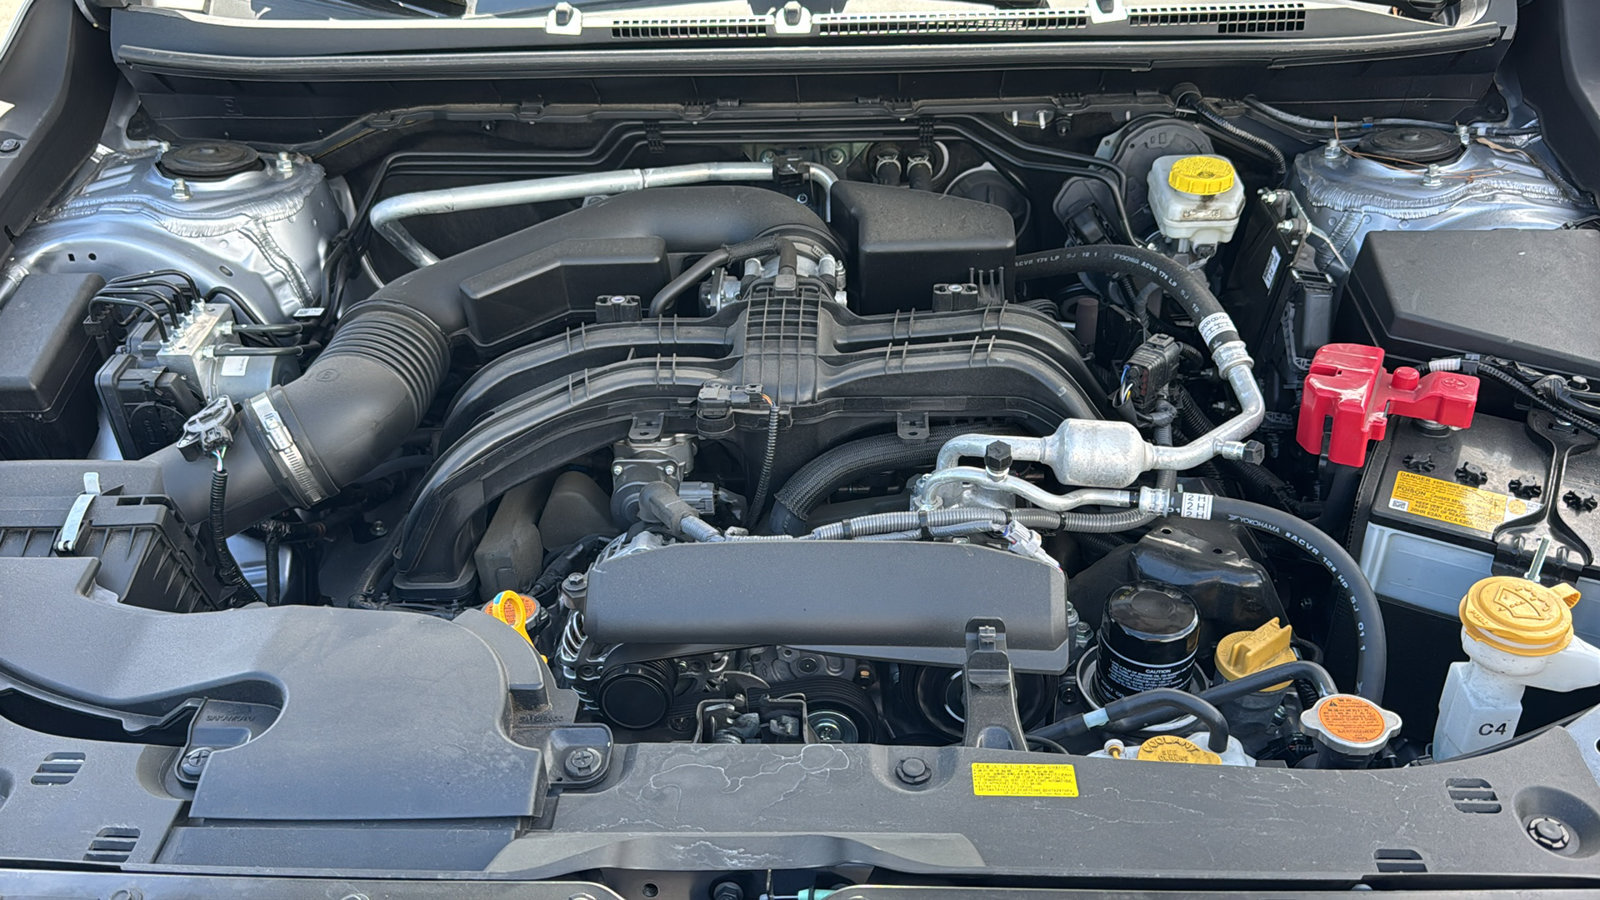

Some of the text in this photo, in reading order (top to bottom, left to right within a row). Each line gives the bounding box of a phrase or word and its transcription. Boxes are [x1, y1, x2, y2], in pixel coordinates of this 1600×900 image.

[1400, 472, 1431, 482] DANGER
[1396, 485, 1426, 496] POISON
[1240, 516, 1280, 533] YOKOHAMA
[1478, 722, 1507, 736] C4
[1142, 736, 1201, 754] COOLANT
